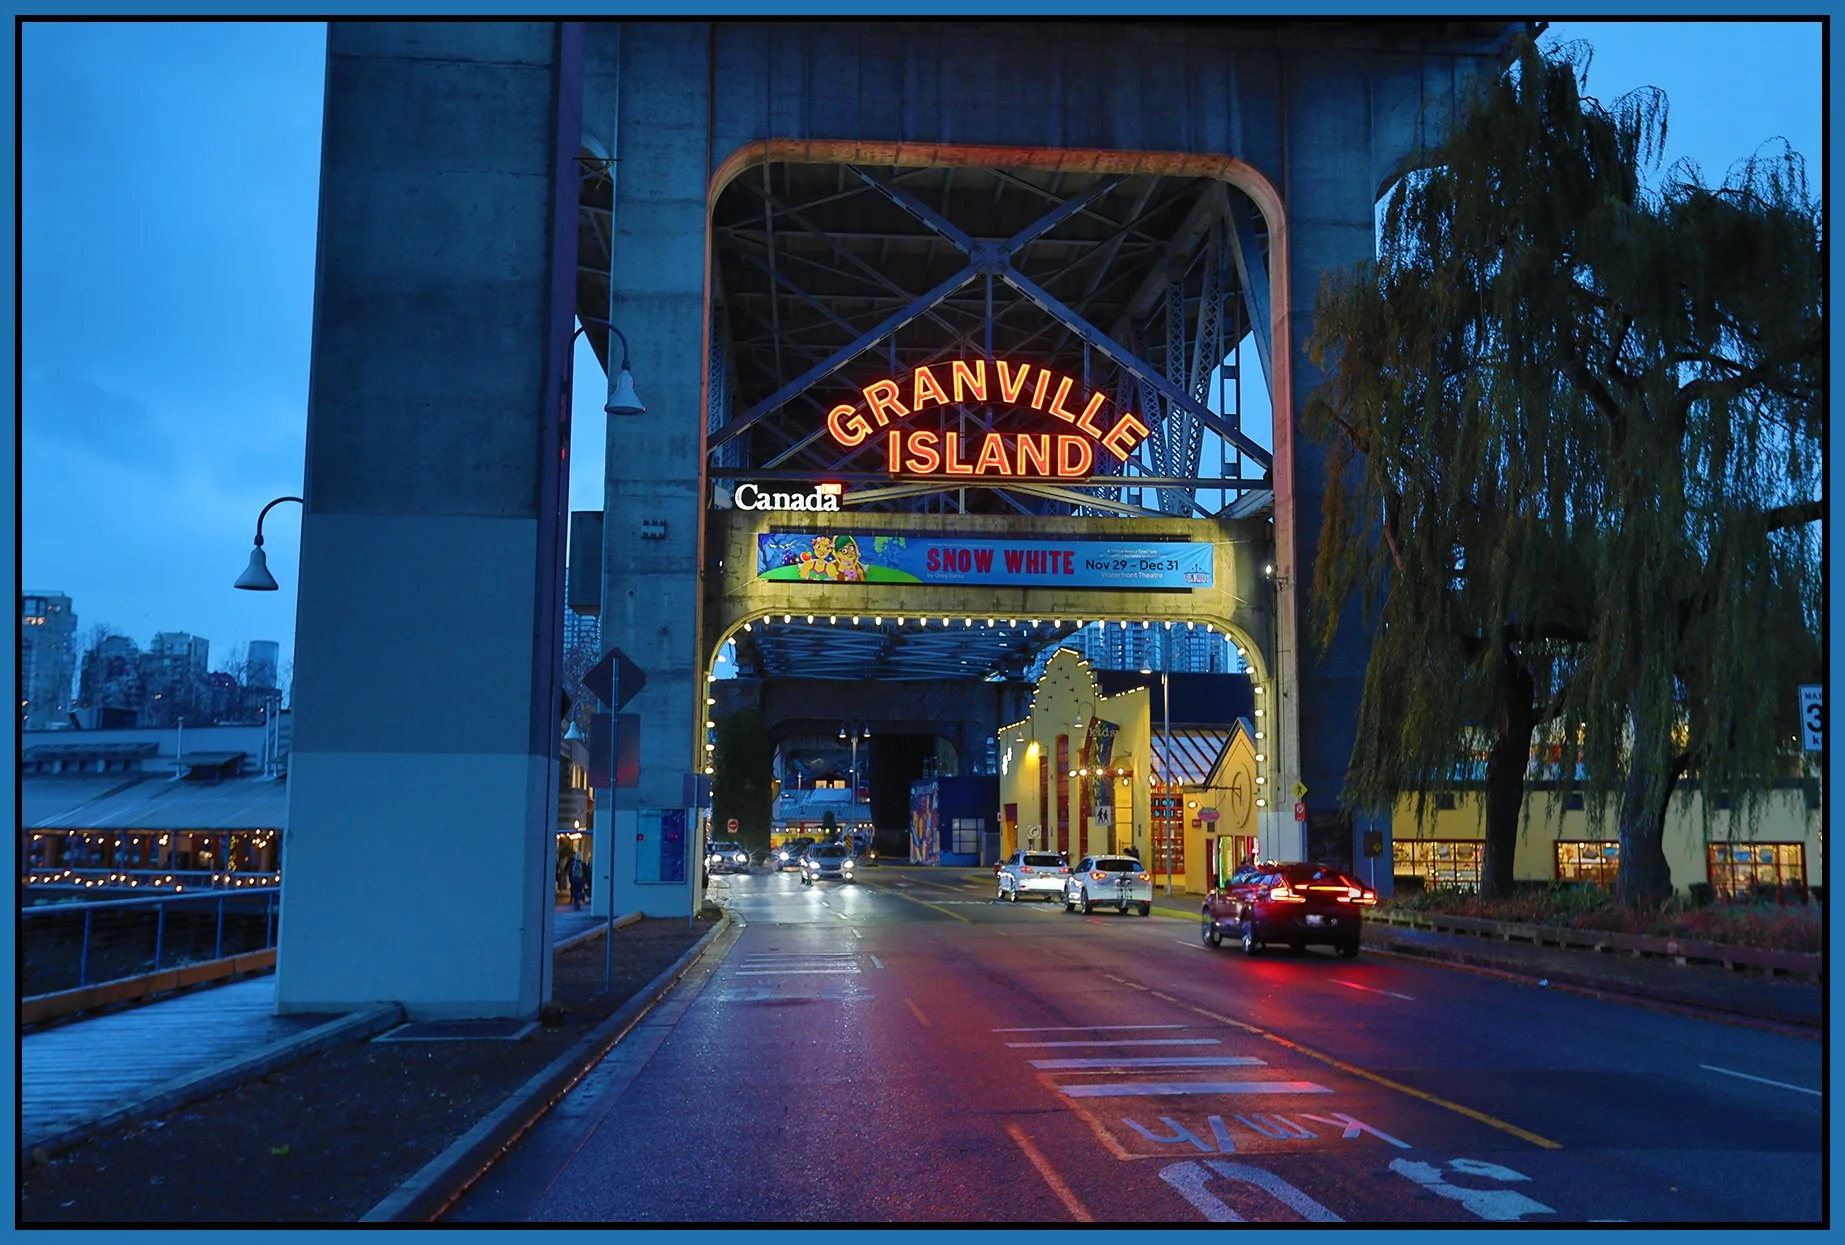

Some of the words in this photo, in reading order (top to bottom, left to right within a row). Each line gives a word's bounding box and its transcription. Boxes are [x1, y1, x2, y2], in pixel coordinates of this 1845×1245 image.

[827, 359, 1151, 462] GRANVILLE
[887, 429, 1093, 477] ISLAND
[734, 483, 841, 511] Canada
[927, 548, 994, 573] SNOW
[1004, 550, 1075, 574] WHITE
[1086, 560, 1110, 570] Nov
[1113, 560, 1127, 570] 29
[1139, 560, 1164, 571] Dec
[1166, 560, 1179, 571] 31
[1089, 727, 1117, 738] Kids
[1120, 1111, 1413, 1154] km/h
